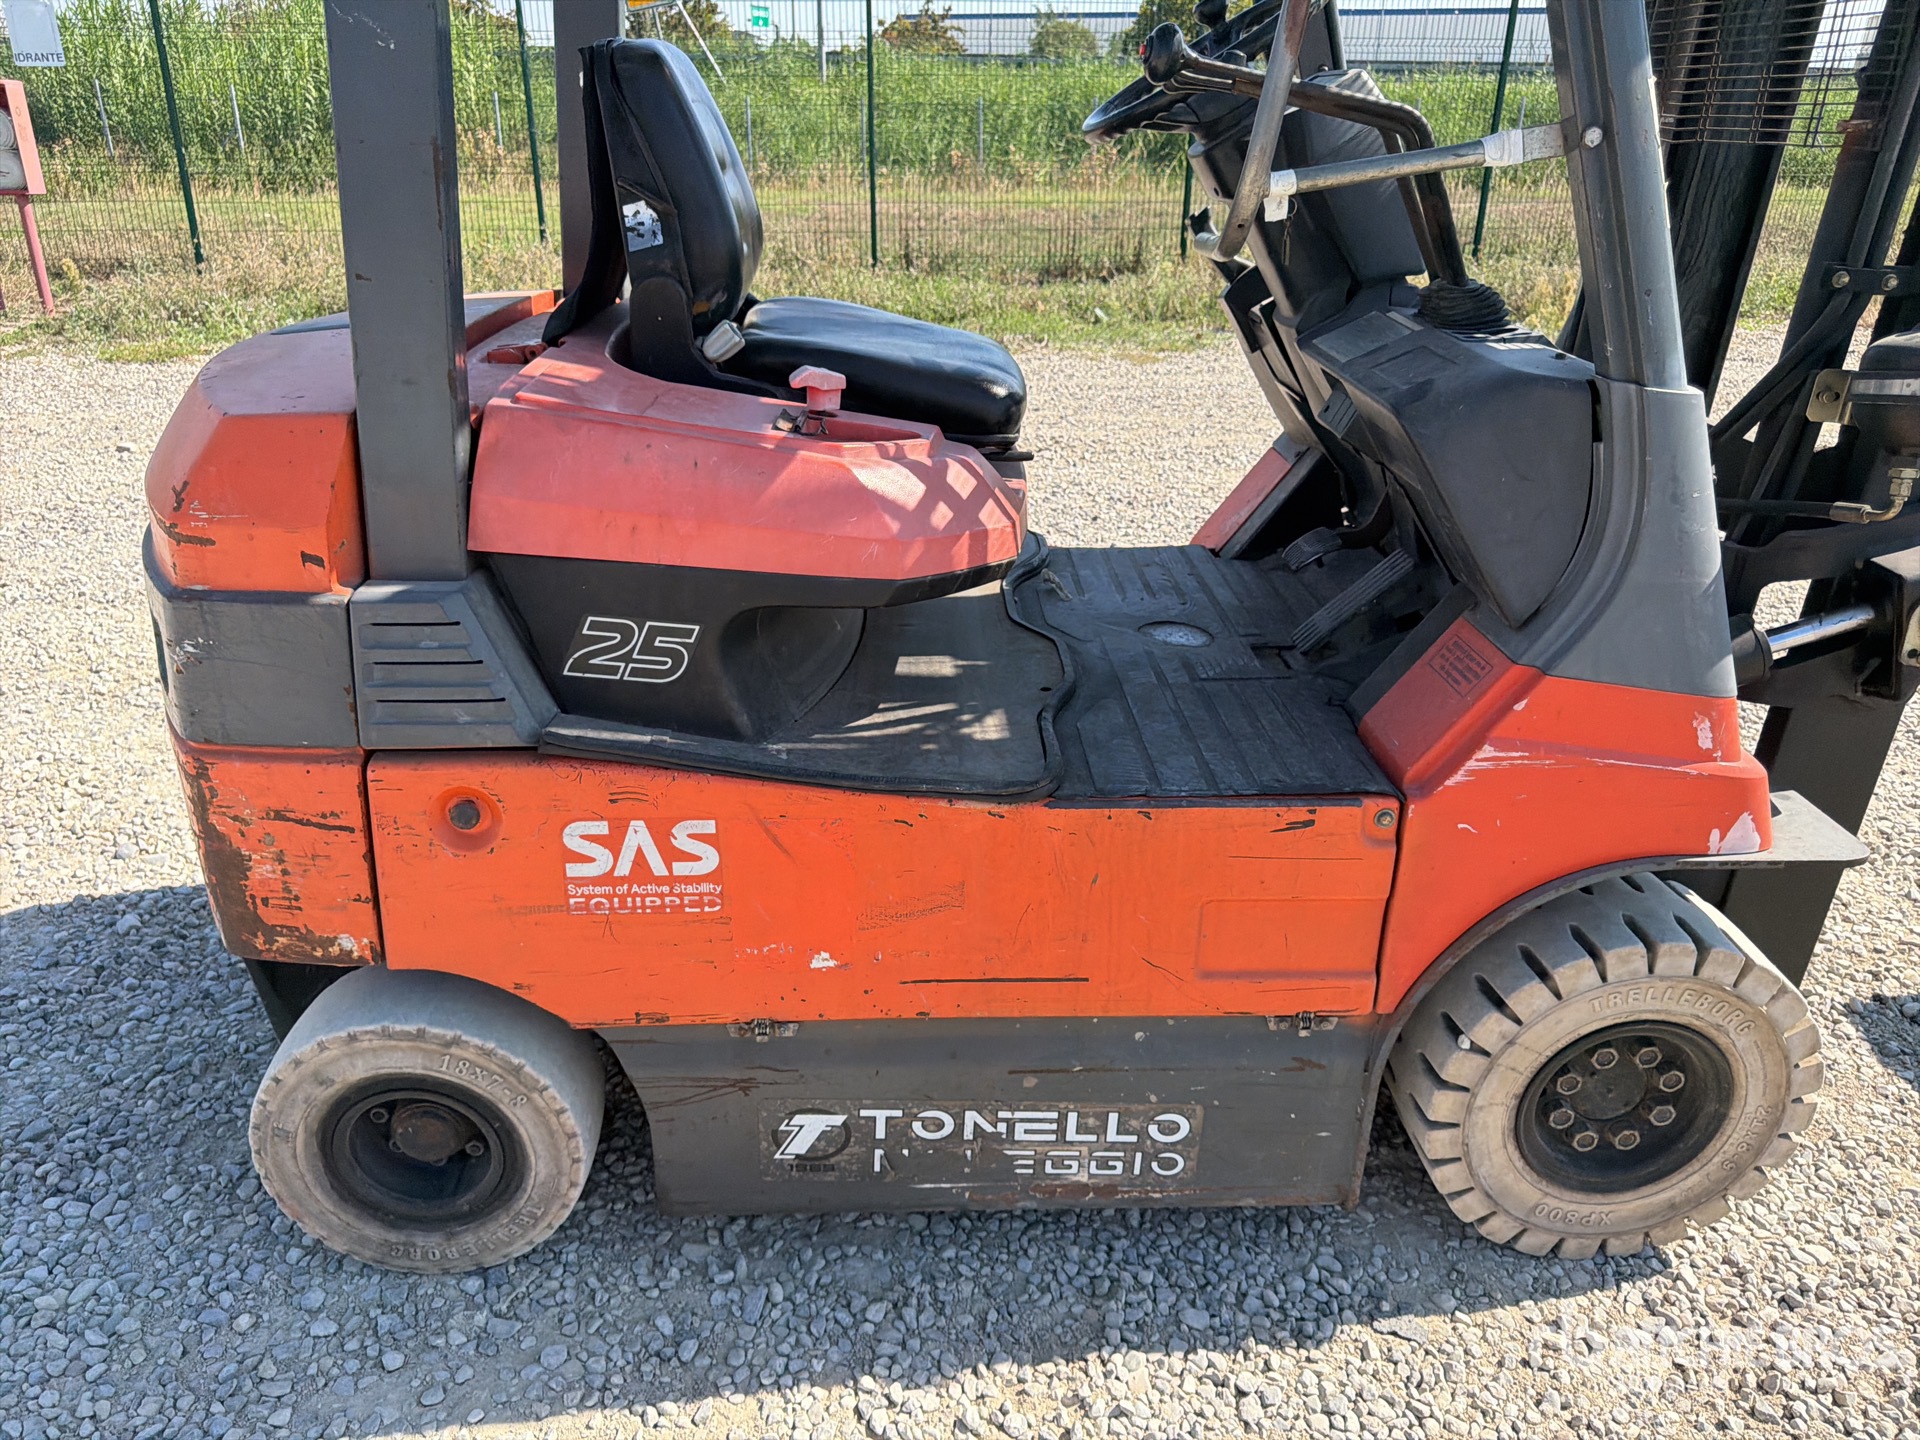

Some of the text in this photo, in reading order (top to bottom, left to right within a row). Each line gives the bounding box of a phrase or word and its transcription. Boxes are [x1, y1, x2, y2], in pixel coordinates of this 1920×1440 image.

[14, 52, 65, 63] IDRANTE
[563, 616, 700, 683] 25
[562, 819, 720, 877] SAS
[567, 882, 723, 896] System of Active Stability
[568, 895, 723, 914] EQUIPPED
[1588, 986, 1757, 1036] TRELLEBORG
[858, 1108, 1192, 1143] TONELLO
[1534, 1203, 1615, 1227] XP800
